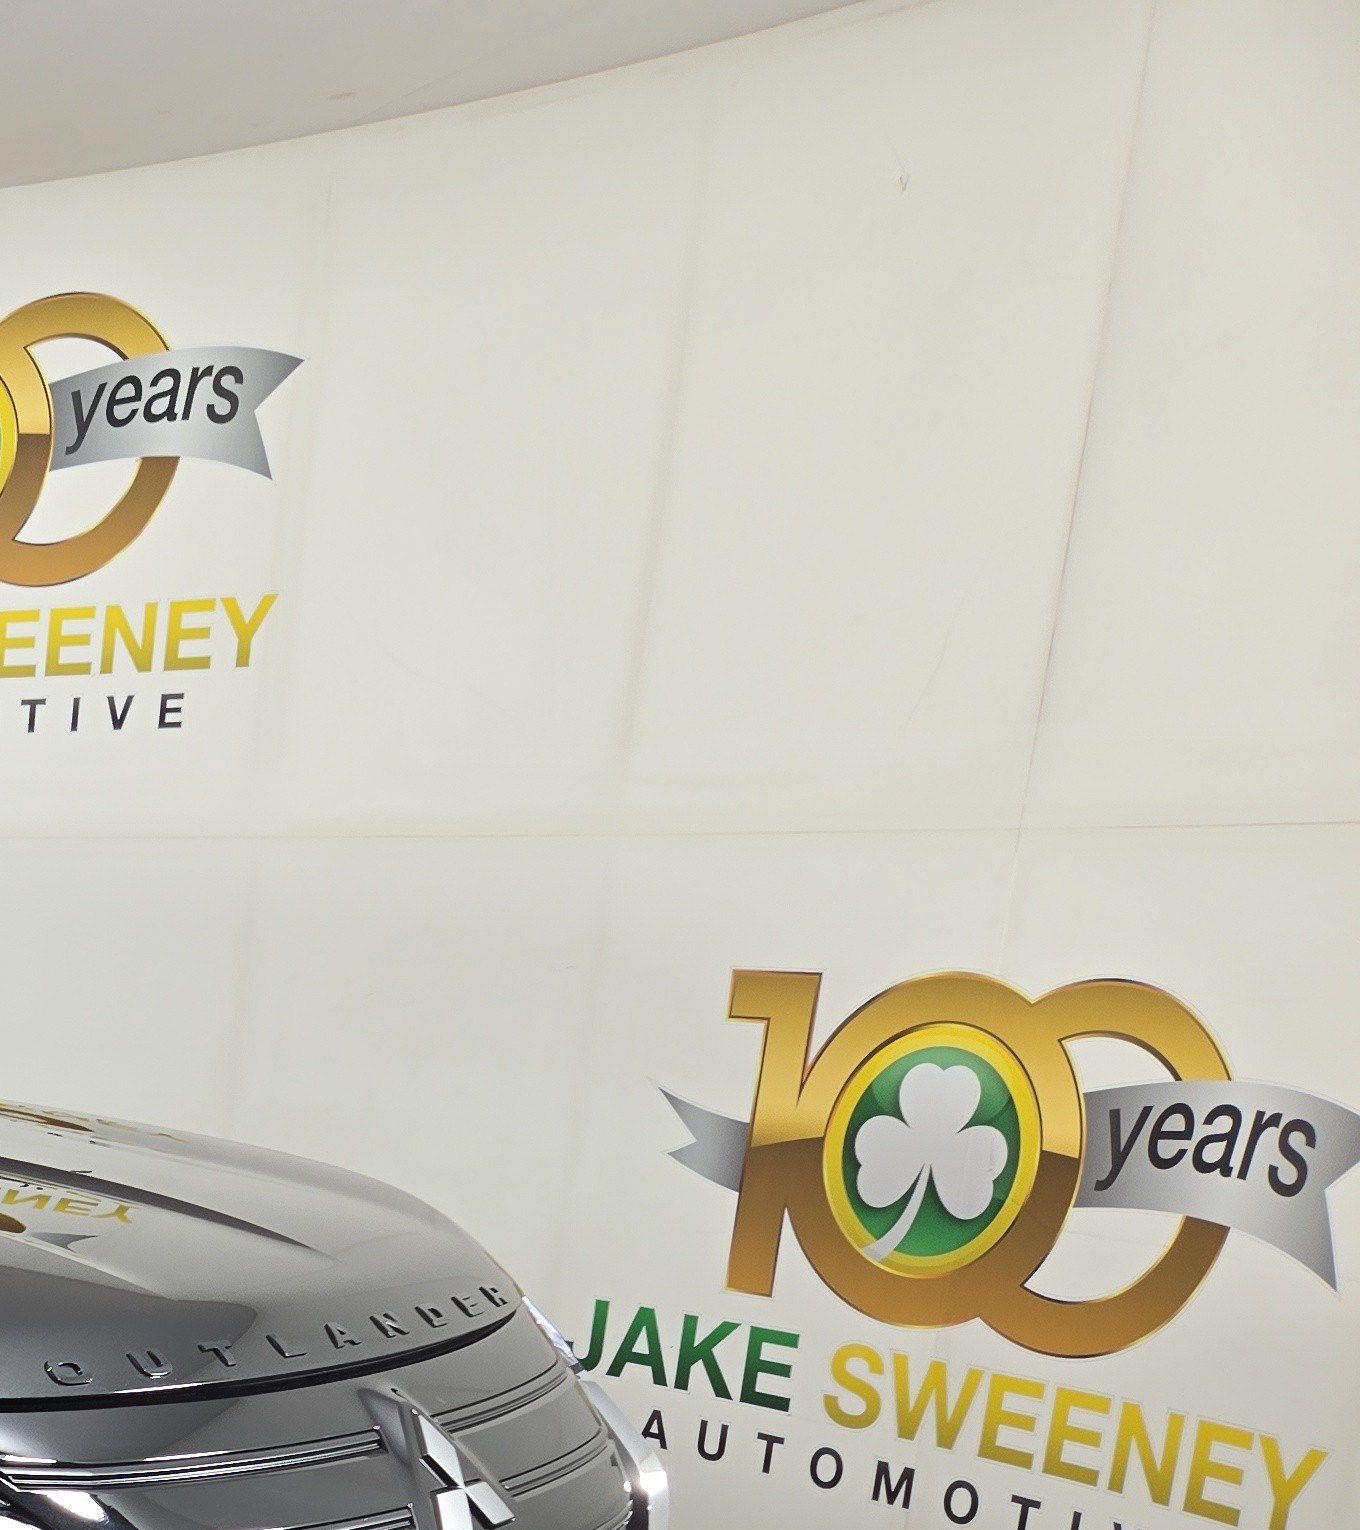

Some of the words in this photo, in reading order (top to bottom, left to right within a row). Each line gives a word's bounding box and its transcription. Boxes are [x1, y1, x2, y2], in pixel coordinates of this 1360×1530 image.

[65, 361, 245, 455] years
[726, 968, 1233, 1359] 100
[1093, 1099, 1319, 1198] years
[44, 1285, 510, 1388] OUTLANDER
[567, 1299, 801, 1414] JAKE
